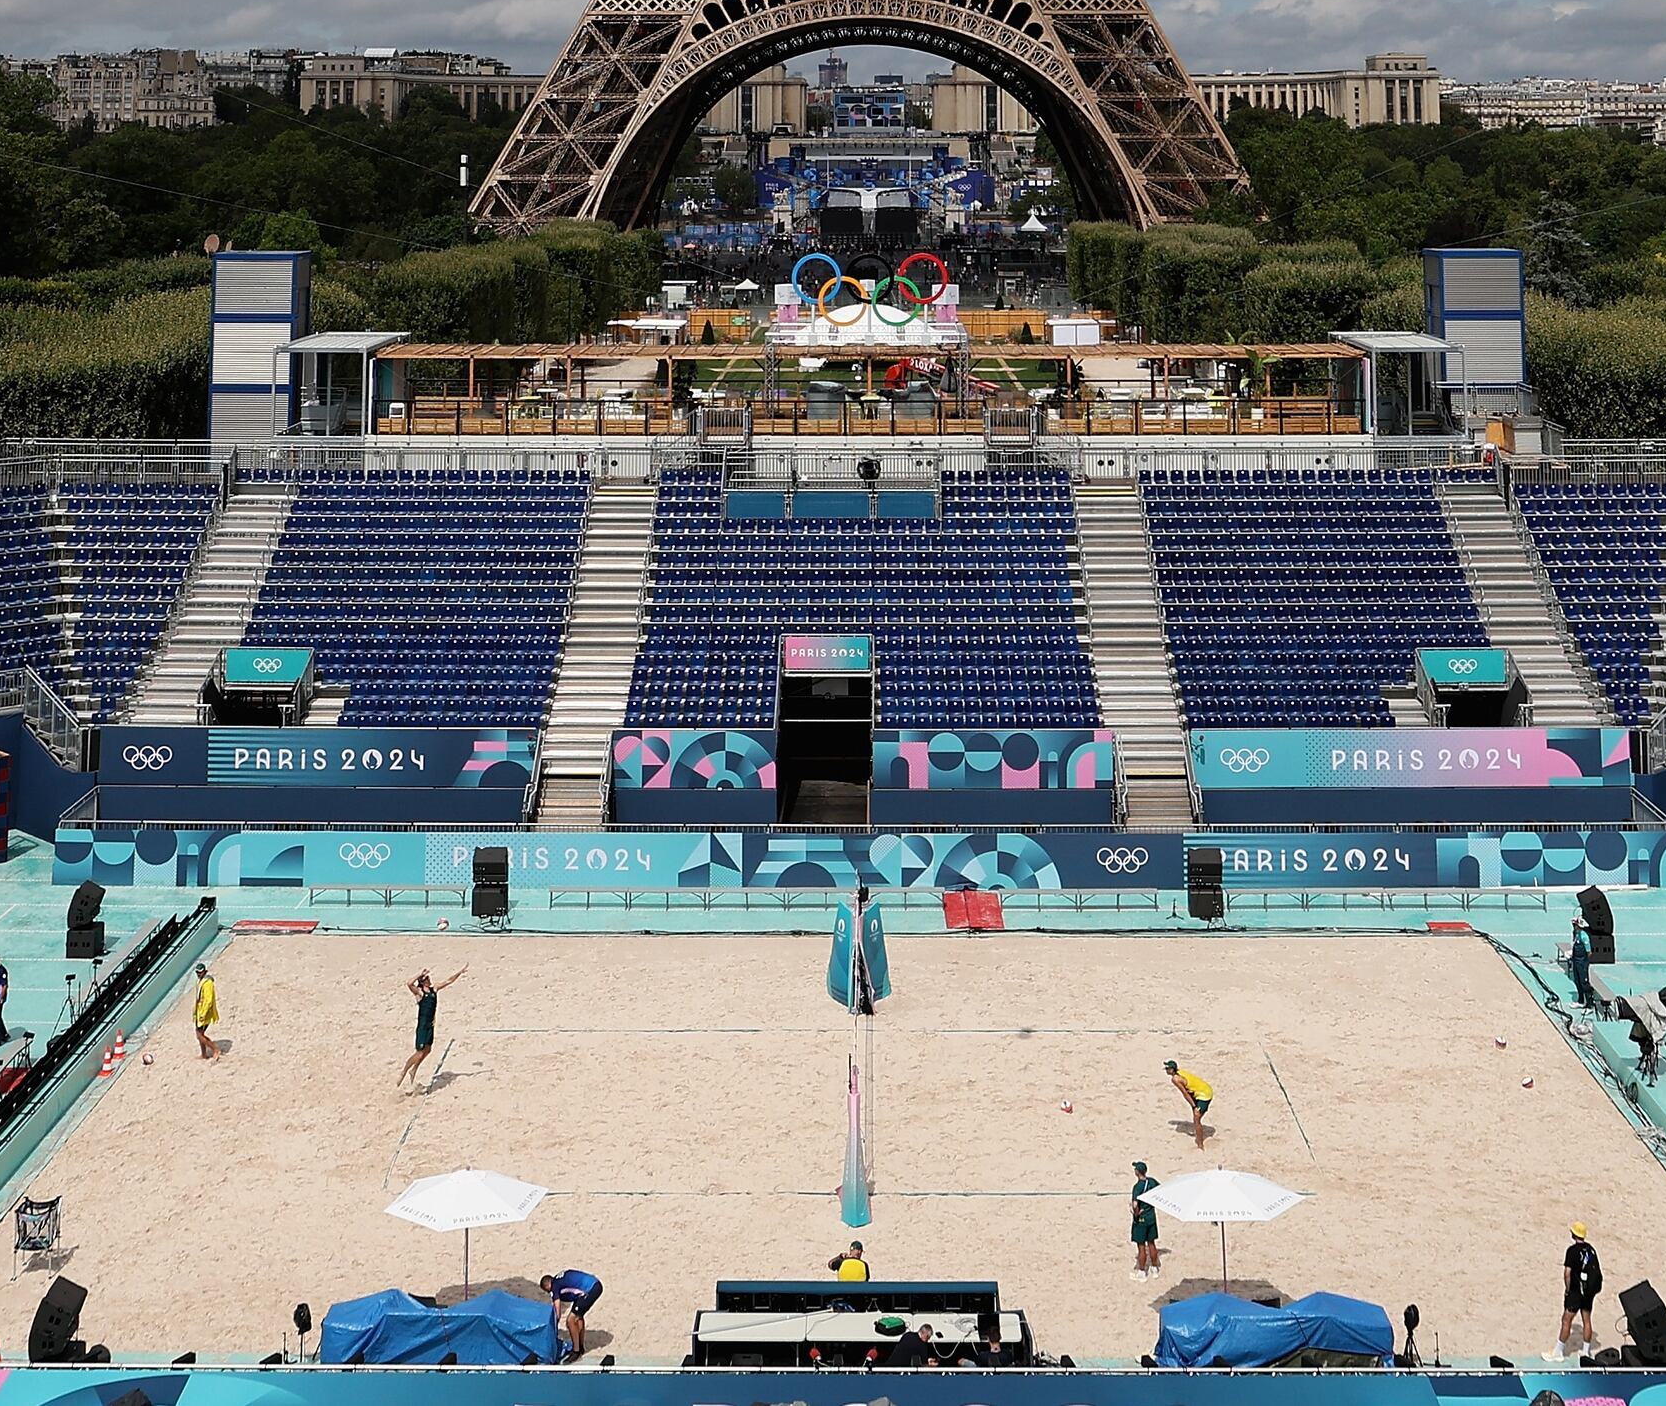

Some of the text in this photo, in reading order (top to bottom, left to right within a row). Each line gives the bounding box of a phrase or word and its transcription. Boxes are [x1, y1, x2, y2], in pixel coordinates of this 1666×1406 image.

[831, 648, 864, 658] 2024
[341, 748, 425, 771] 2024
[1438, 748, 1521, 770] 2024
[453, 846, 651, 871] PIS 2024
[1322, 848, 1410, 872] 2024
